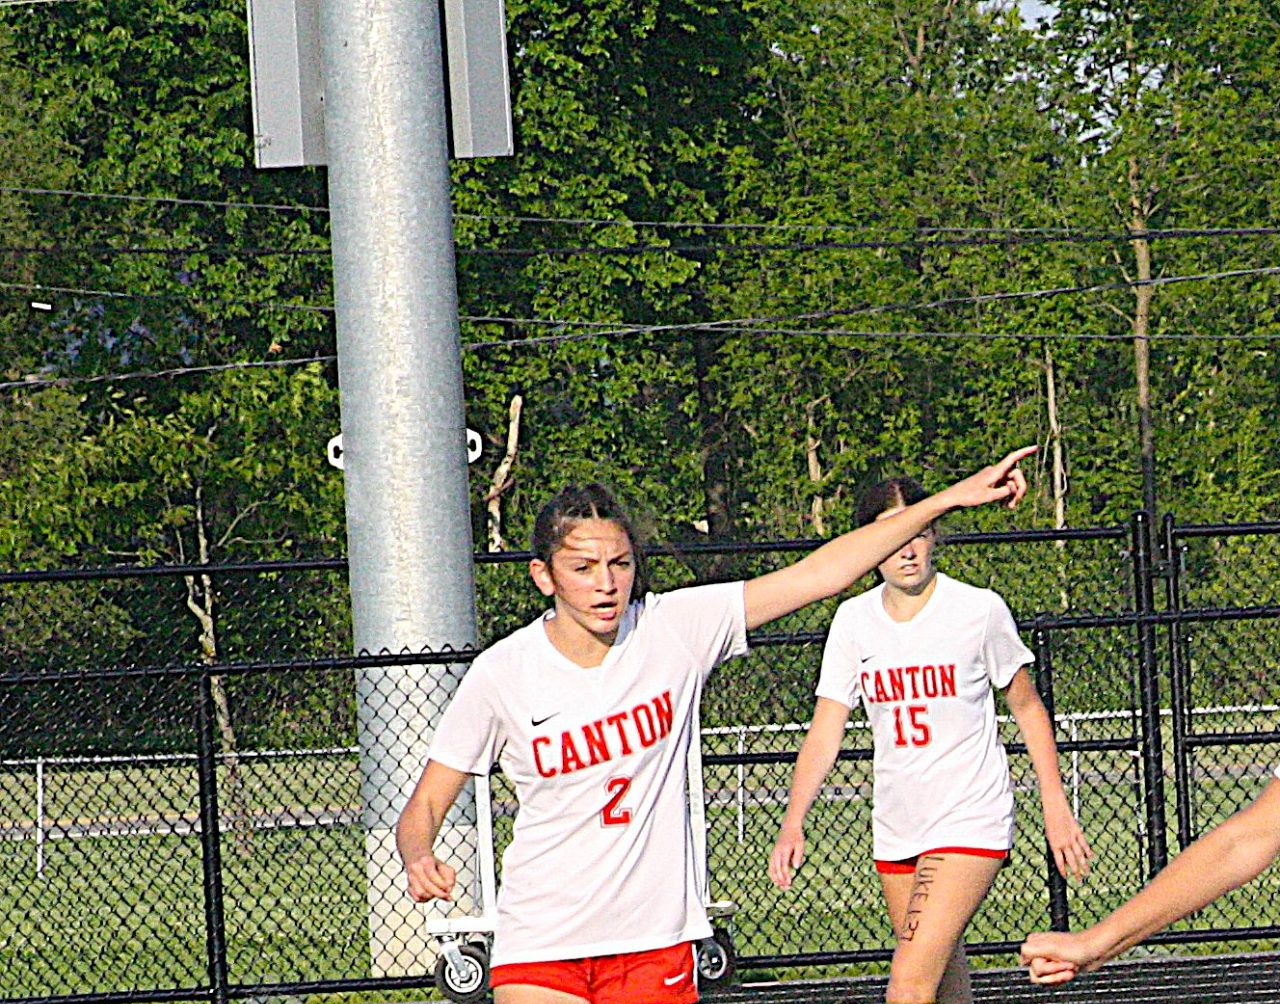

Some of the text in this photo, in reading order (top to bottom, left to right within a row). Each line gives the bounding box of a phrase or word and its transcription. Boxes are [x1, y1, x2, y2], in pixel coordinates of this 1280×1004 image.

[861, 664, 957, 703] CANTON
[531, 689, 674, 779] CANTON
[892, 704, 932, 748] 15
[600, 775, 632, 828] 2
[910, 855, 944, 906] LUKE
